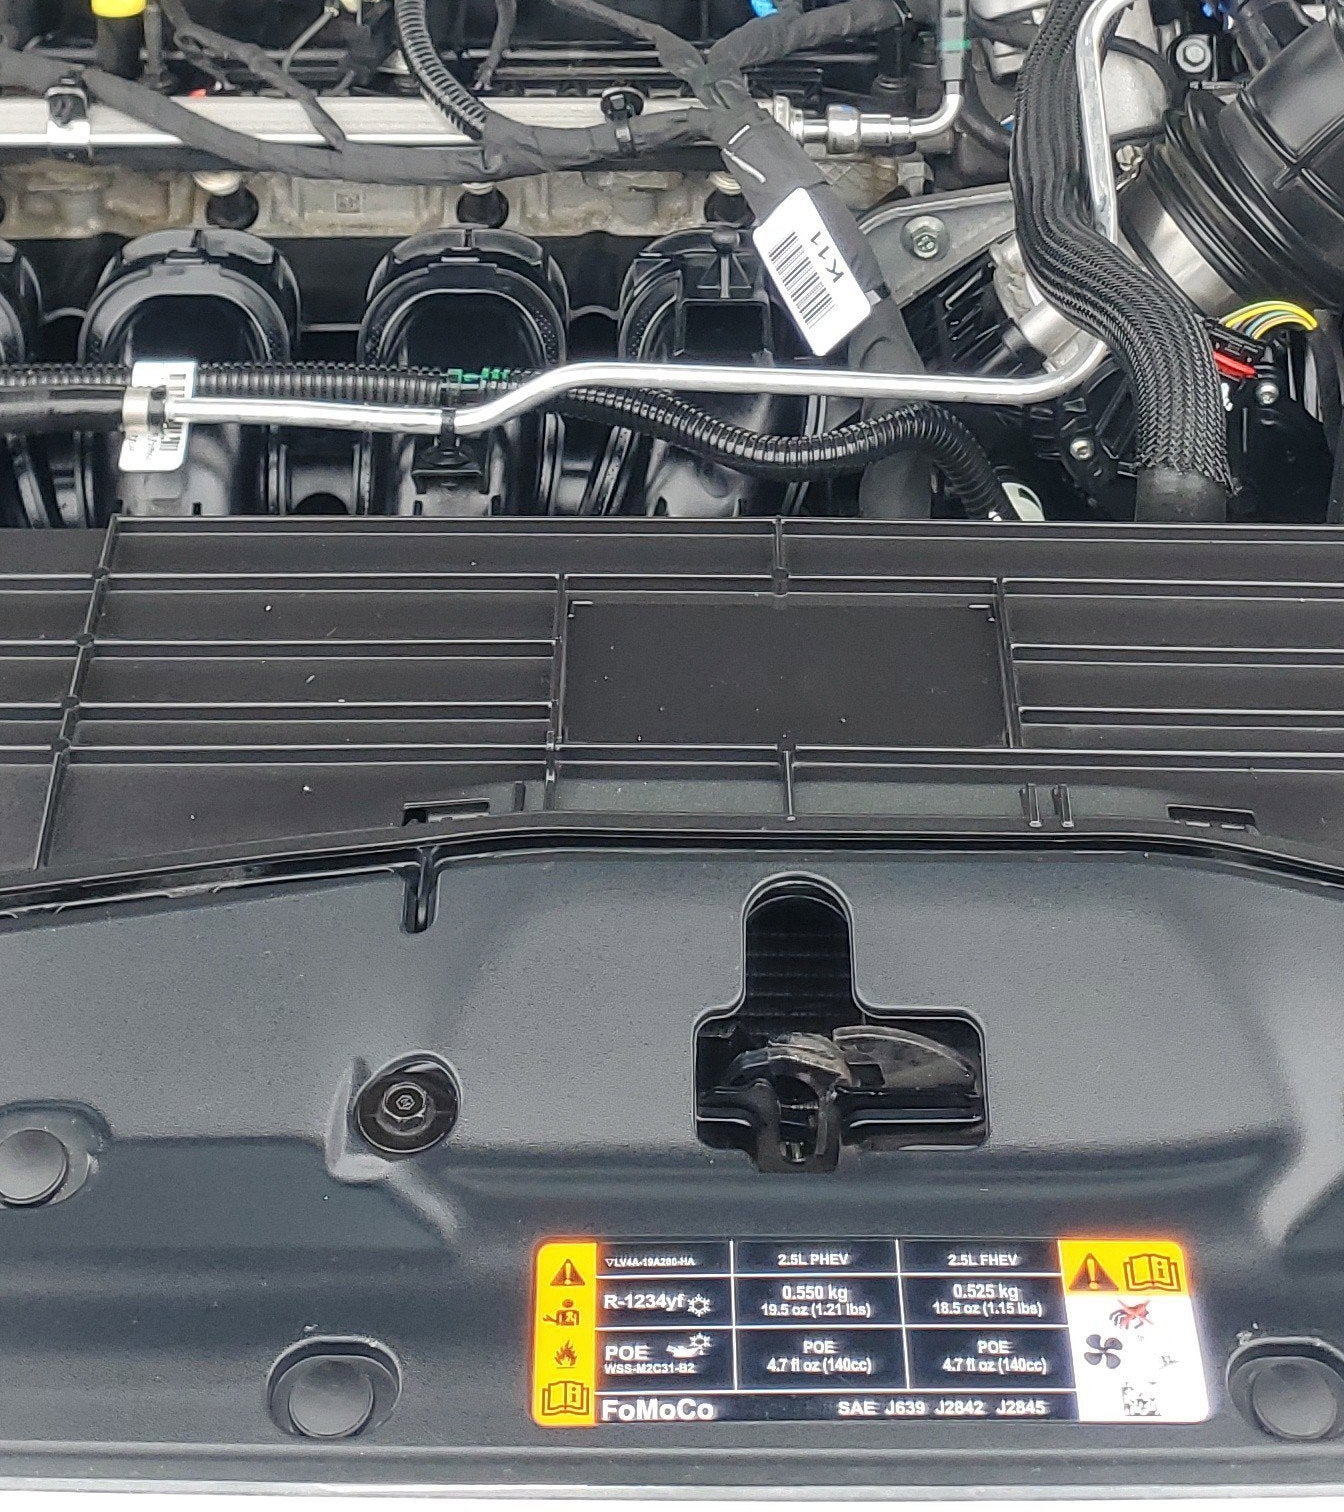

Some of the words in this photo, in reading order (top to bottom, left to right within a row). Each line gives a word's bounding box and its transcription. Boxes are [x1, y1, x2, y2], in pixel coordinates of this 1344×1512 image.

[810, 231, 845, 283] K11
[777, 1253, 808, 1266] 2.5L
[810, 1253, 849, 1266] PHEV
[947, 1253, 979, 1267] 2.5L
[980, 1253, 1019, 1267] FHEV
[782, 1284, 824, 1300] 0.550
[828, 1284, 848, 1303] kg
[953, 1283, 994, 1299] 0.525
[999, 1283, 1019, 1302] kg
[603, 1293, 685, 1312] R-1234yf
[761, 1303, 789, 1316] 19.5
[792, 1305, 809, 1316] oz
[811, 1302, 842, 1319] (1.21
[846, 1302, 872, 1319] lbs)
[932, 1301, 961, 1315] 18.5
[964, 1304, 981, 1315] oz
[983, 1301, 1014, 1318] (1.15
[1017, 1301, 1043, 1318] lbs)
[604, 1345, 650, 1361] POE
[803, 1340, 836, 1354] POE
[977, 1340, 1011, 1354] POE
[766, 1357, 788, 1372] 4.7
[790, 1357, 800, 1372] fl
[803, 1360, 821, 1372] oz
[823, 1357, 872, 1375] (140cc)
[942, 1357, 963, 1372] 4.7
[966, 1357, 975, 1372] fl
[978, 1360, 997, 1372] oz
[998, 1357, 1047, 1375] (140cc)
[601, 1398, 714, 1421] FoMoCo
[838, 1400, 877, 1416] SAE
[885, 1399, 926, 1416] J639
[934, 1399, 985, 1416] J2842
[996, 1399, 1047, 1416] J2845
